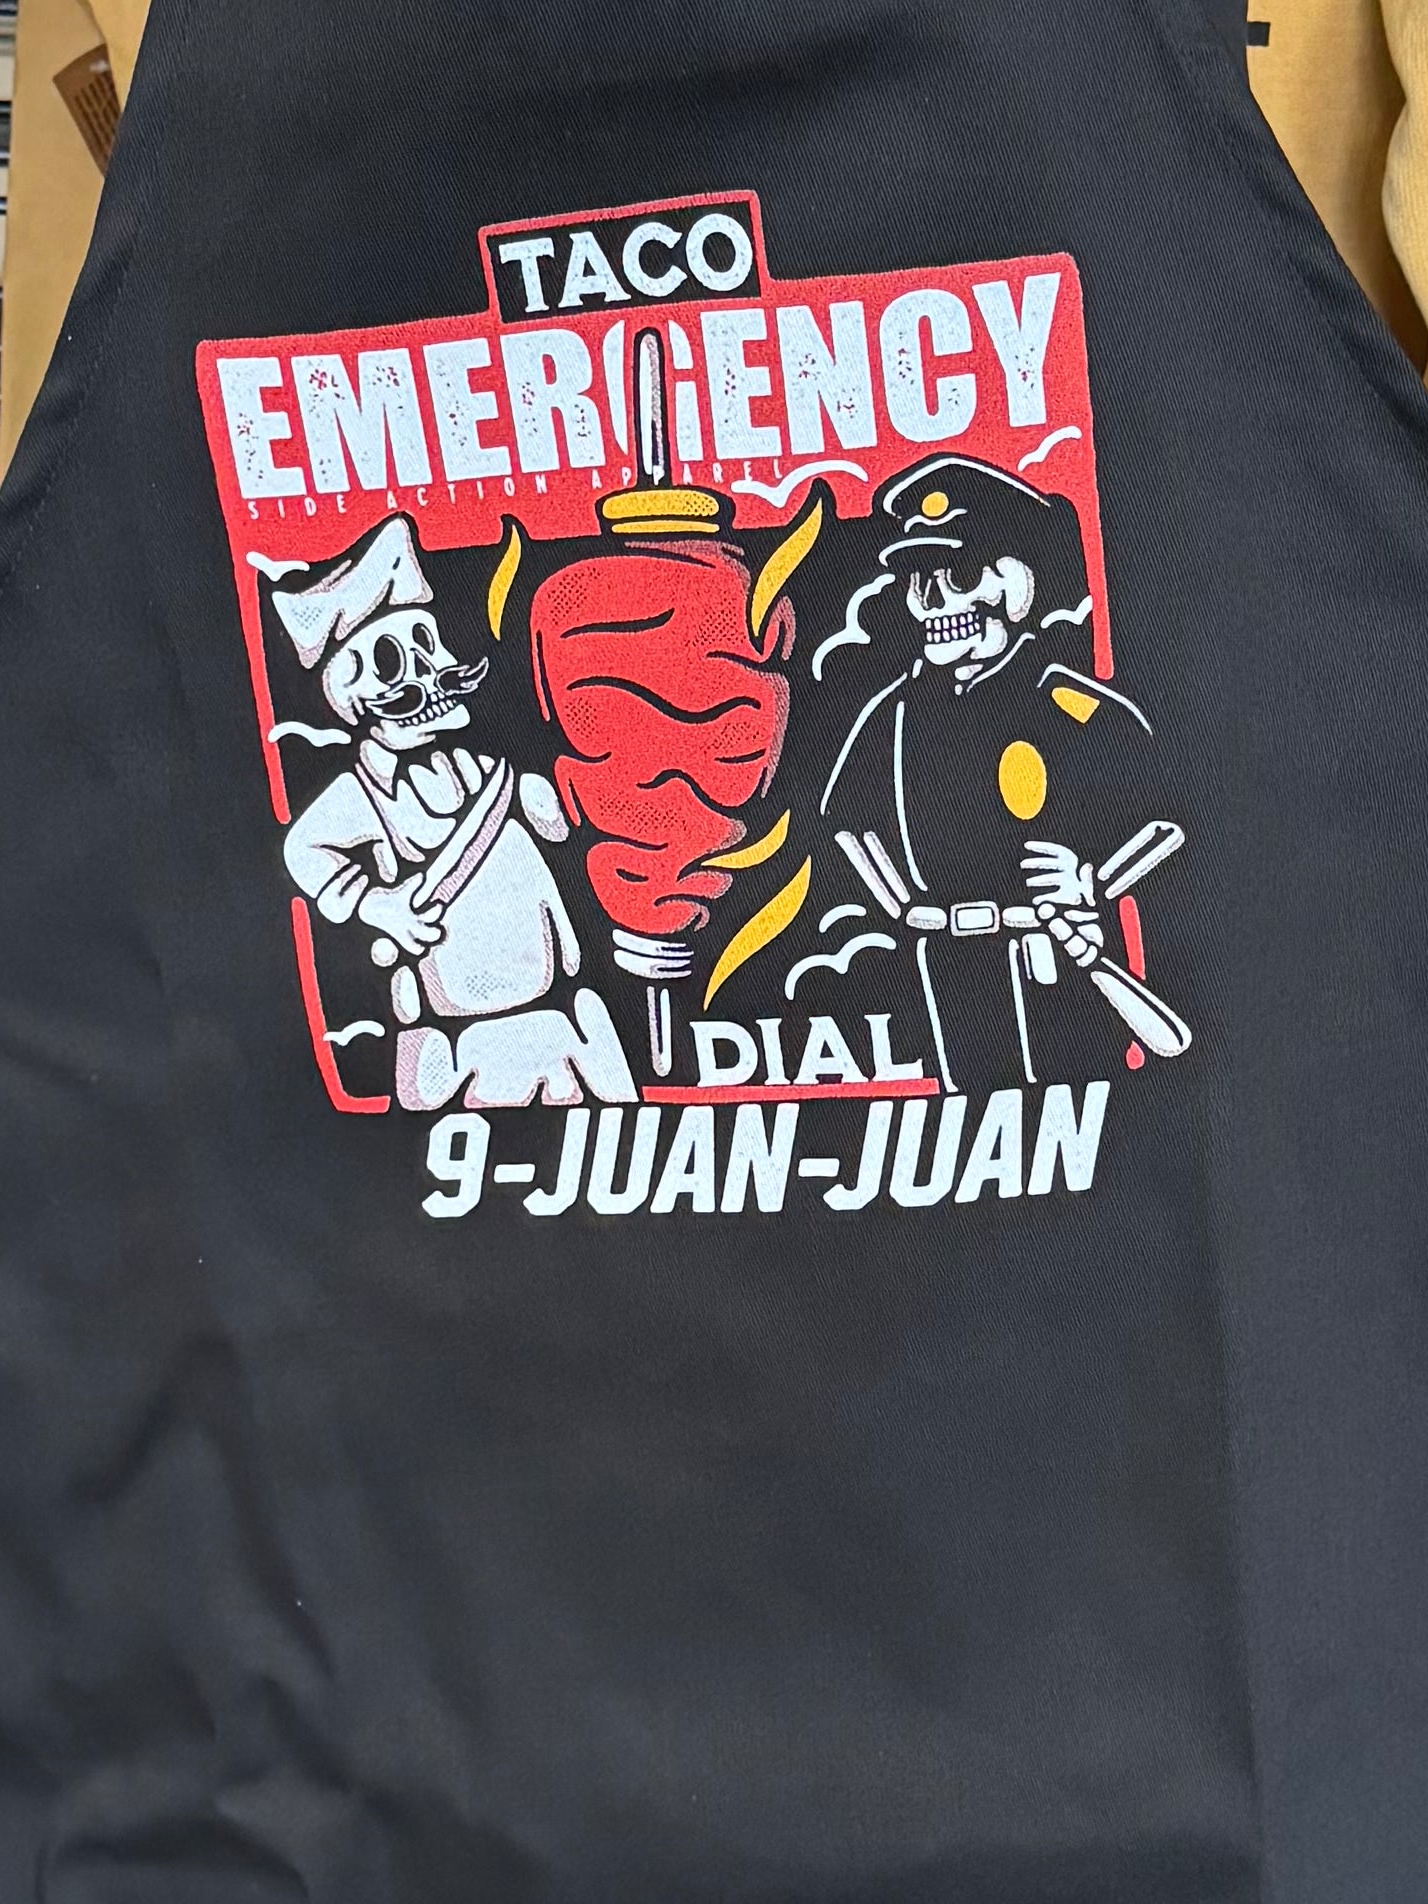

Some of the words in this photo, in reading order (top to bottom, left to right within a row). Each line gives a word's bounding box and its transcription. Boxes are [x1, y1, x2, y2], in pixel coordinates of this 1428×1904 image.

[498, 212, 754, 314] TACO
[216, 271, 1062, 500] EMERGENCY
[248, 495, 349, 521] SIDE
[385, 473, 549, 510] ACTION
[590, 459, 785, 490] APPAREL
[688, 1013, 924, 1088] DIAL
[421, 1080, 1111, 1218] 9-JUAN-JUAN
